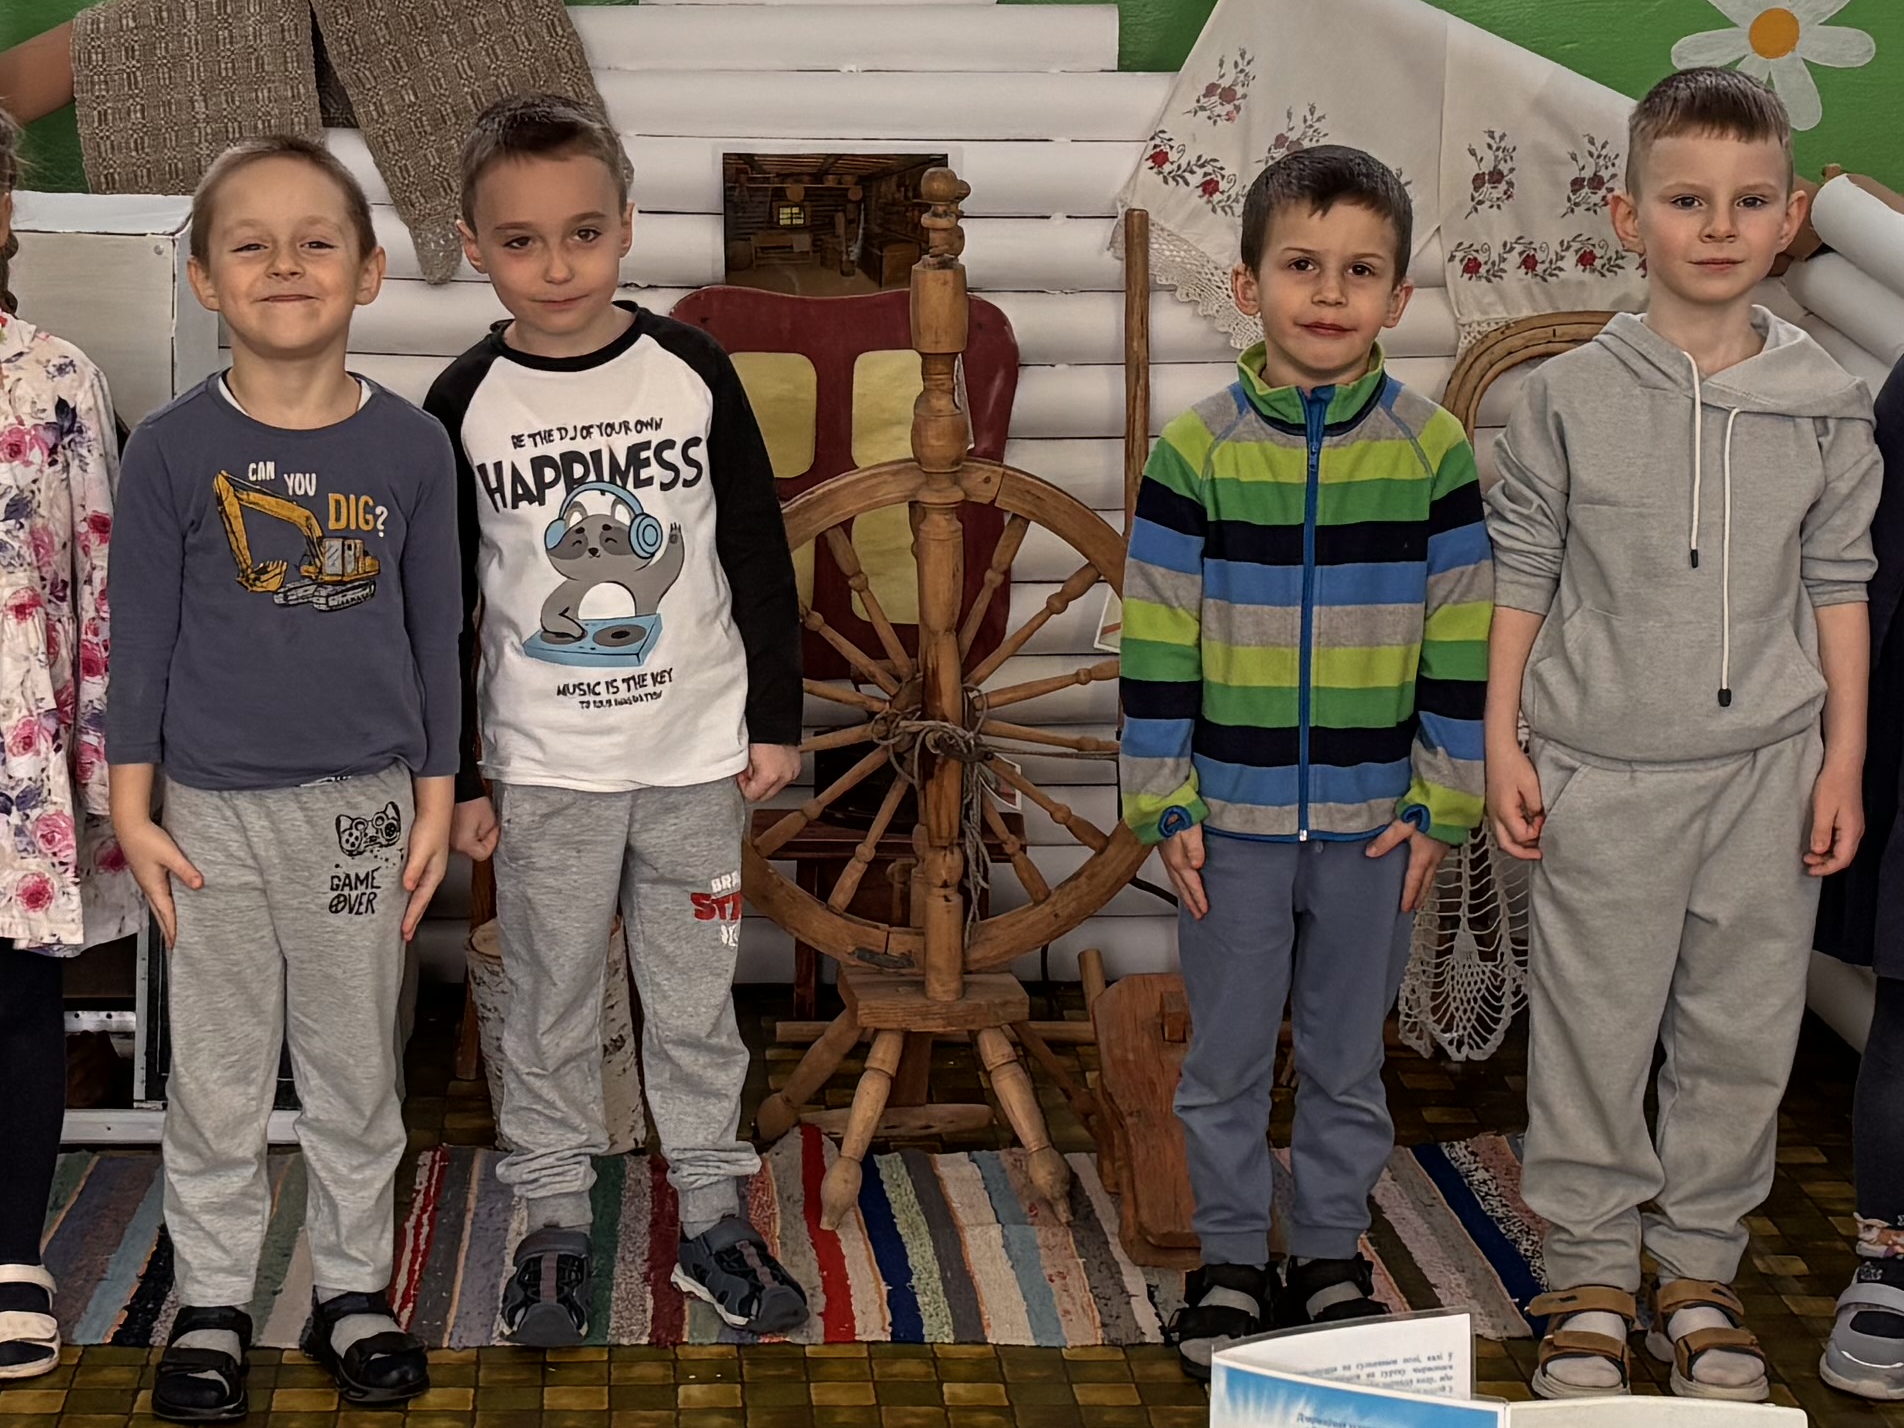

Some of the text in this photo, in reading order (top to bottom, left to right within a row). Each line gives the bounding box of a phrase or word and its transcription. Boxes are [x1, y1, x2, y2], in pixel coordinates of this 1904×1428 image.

[528, 429, 555, 448] THE
[580, 424, 594, 440] OF
[596, 420, 633, 438] YOUR
[634, 417, 663, 434] OWN
[476, 436, 703, 513] HAPPINESS
[248, 461, 388, 537] CAN YOU DIG?
[556, 667, 673, 697] MUSIC IS THE KEY
[329, 868, 382, 892] GAME
[329, 891, 378, 916] OVER
